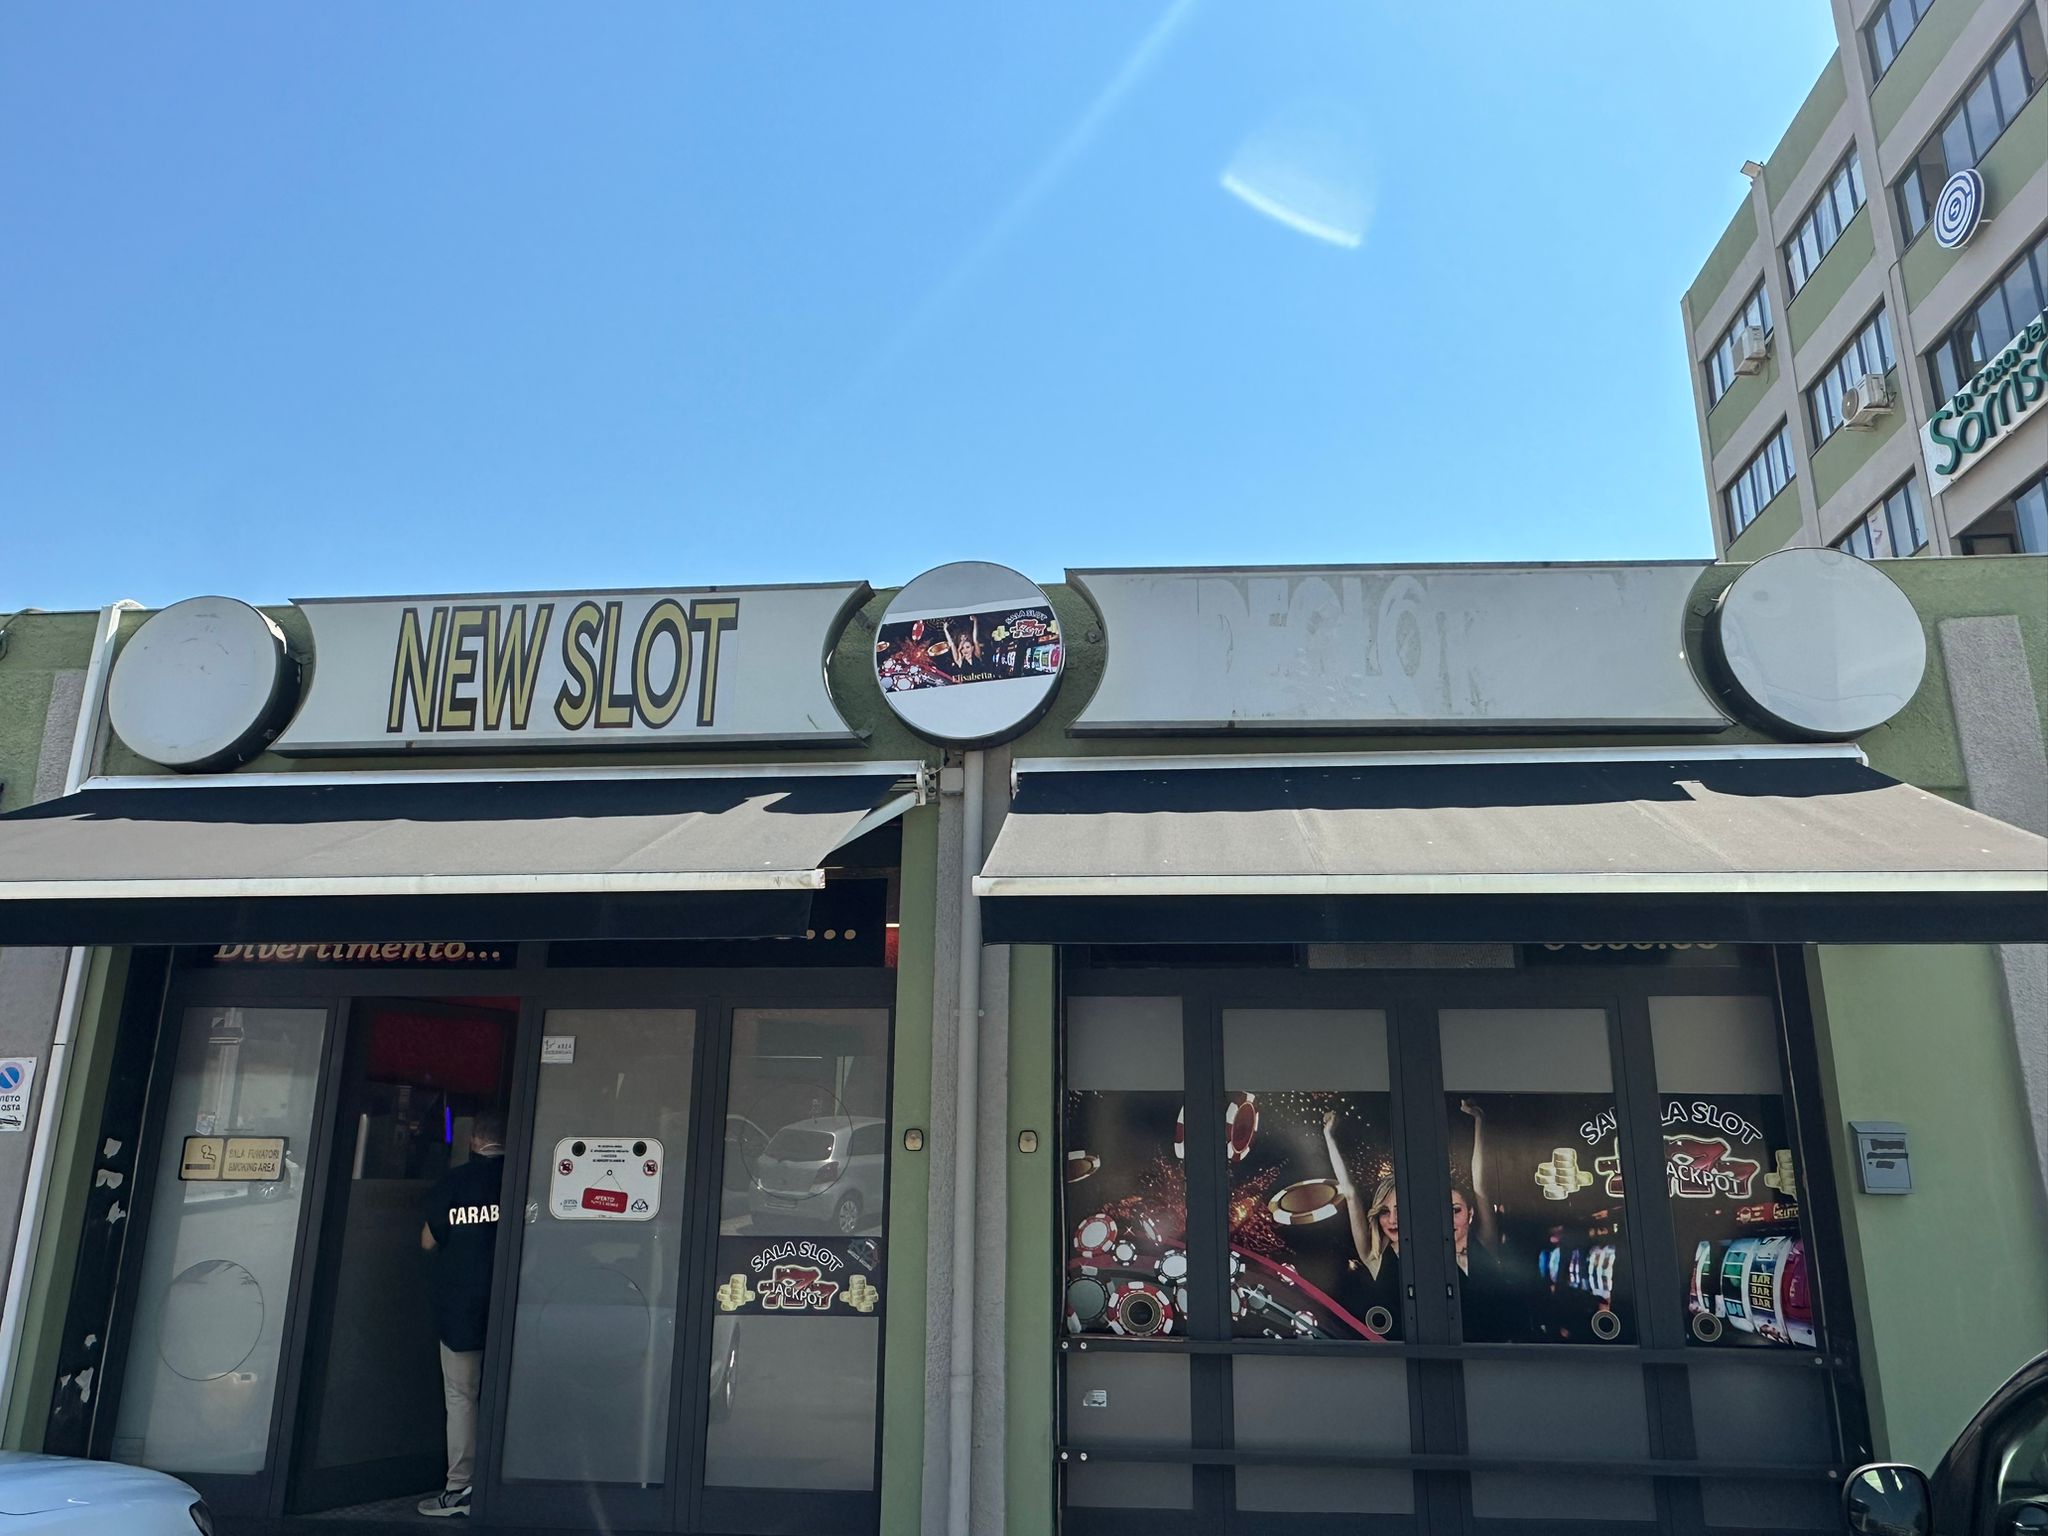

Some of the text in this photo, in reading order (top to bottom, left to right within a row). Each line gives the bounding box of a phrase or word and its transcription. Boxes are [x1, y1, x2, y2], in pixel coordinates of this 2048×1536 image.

[386, 598, 740, 733] NEW SLOT
[1692, 1101, 1763, 1145] SLOT
[258, 1162, 275, 1172] AREA
[751, 1241, 796, 1273] SALA
[799, 1241, 844, 1272] SLOT
[1751, 1274, 1771, 1285] BAR
[770, 1282, 824, 1307] JACKPOT
[1751, 1285, 1770, 1297] BAR
[1752, 1297, 1771, 1309] BAR
